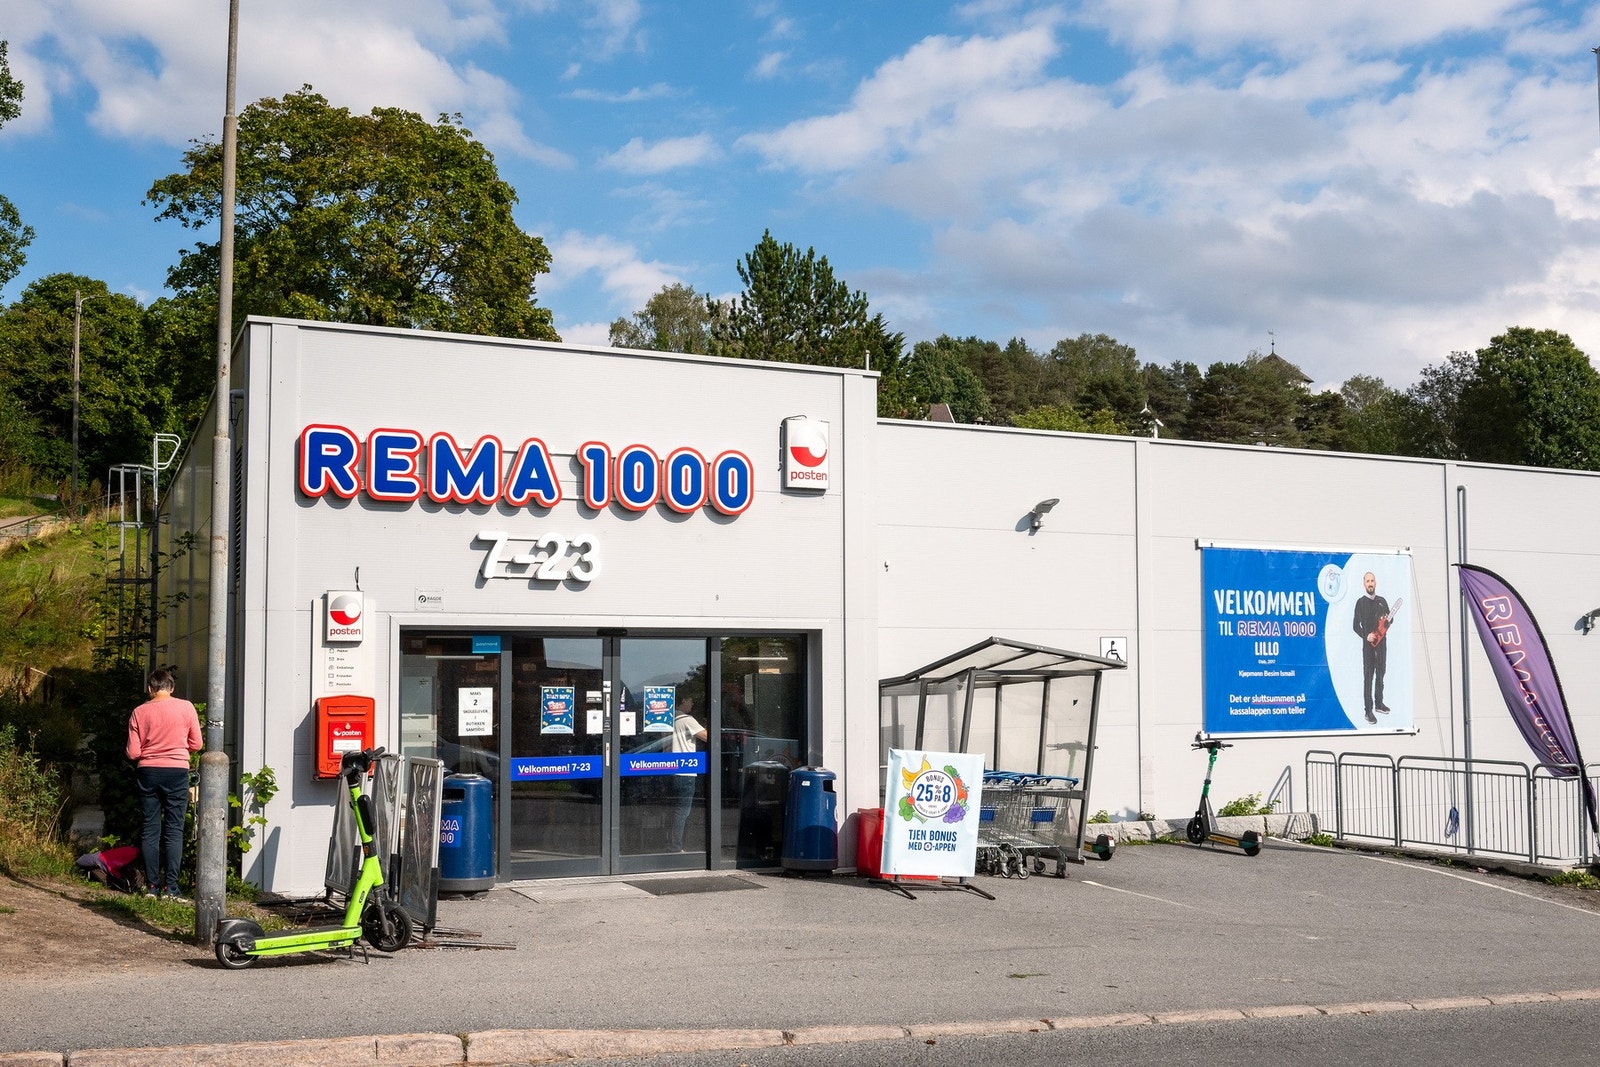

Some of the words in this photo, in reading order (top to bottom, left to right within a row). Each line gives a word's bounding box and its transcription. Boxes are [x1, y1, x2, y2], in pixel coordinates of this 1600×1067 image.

[300, 423, 562, 508] REMA
[577, 441, 754, 515] 1000
[791, 470, 827, 481] posten
[478, 531, 601, 581] 7-23
[1214, 589, 1316, 616] VELKOMMEN
[330, 627, 361, 636] posten
[1218, 621, 1233, 636] TIL
[1237, 620, 1281, 636] REMA
[1283, 621, 1317, 637] 1000
[1255, 641, 1279, 656] LILLO
[1230, 694, 1242, 703] Det
[1252, 694, 1295, 703] sluttsummen
[1296, 693, 1306, 704] på
[1230, 707, 1271, 716] kassalappen
[1288, 706, 1306, 715] teller
[518, 764, 570, 773] Velkommen!
[572, 763, 591, 772] 7-23
[630, 760, 679, 769] Velkommen!
[680, 759, 698, 767] 7-23
[926, 775, 944, 783] BONUS
[916, 783, 933, 802] 25
[942, 785, 951, 803] 8
[441, 819, 459, 831] MA
[440, 832, 454, 844] 00
[909, 829, 926, 840] TJEN
[929, 830, 957, 842] BONUS
[908, 842, 922, 850] MED
